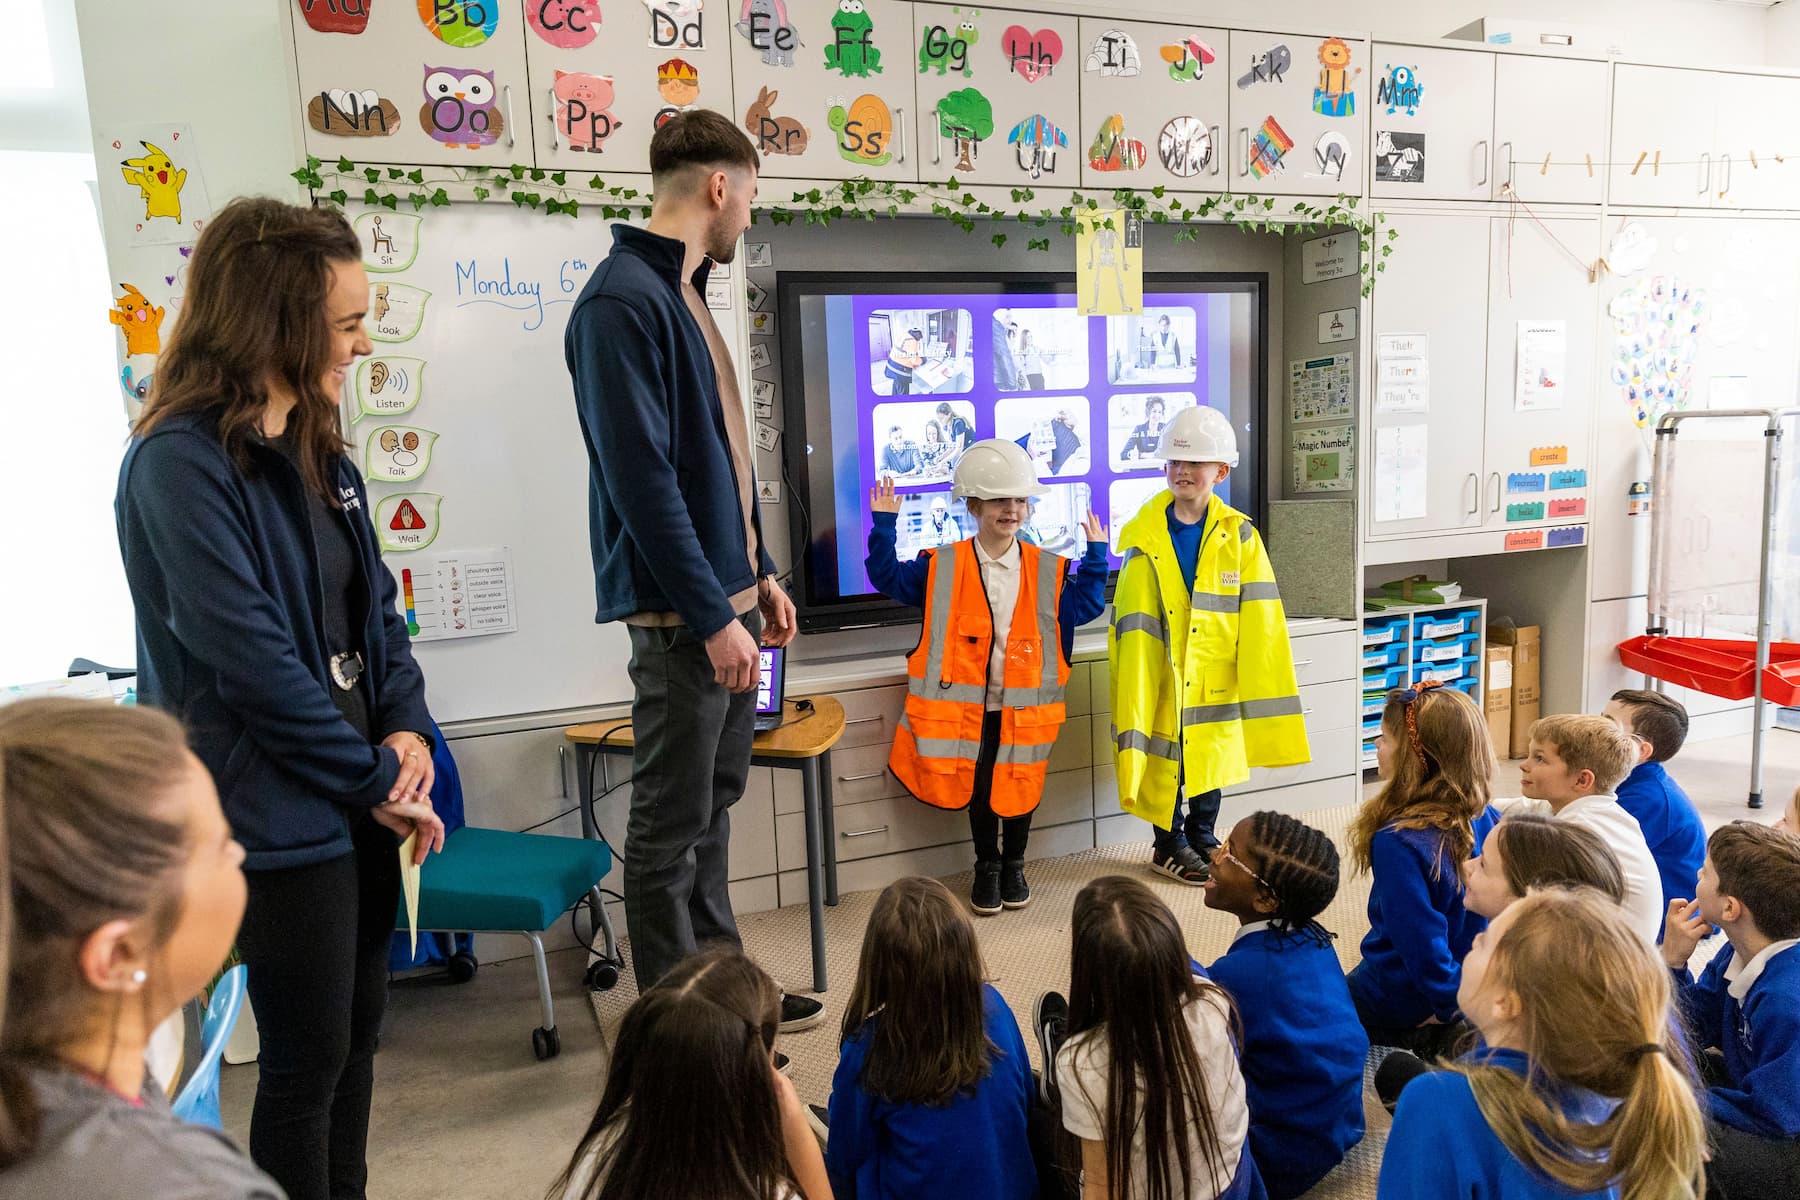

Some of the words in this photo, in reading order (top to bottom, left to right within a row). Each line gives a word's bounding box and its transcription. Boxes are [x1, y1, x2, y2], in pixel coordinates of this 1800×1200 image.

[433, 0, 486, 28] Bb
[539, 0, 588, 32] Cc
[653, 8, 704, 49] Dd
[749, 12, 794, 50] Ee
[835, 26, 873, 65] Ff
[926, 25, 968, 71] Gg
[1010, 39, 1053, 76] Hh
[1102, 37, 1127, 69] Ii
[1174, 40, 1203, 81] Jj
[1252, 53, 1283, 83] Kk
[1377, 77, 1419, 107] Mm
[321, 91, 388, 133] Nn
[431, 96, 490, 134] Oo
[567, 99, 611, 149] Pp
[759, 117, 801, 153] Rr
[841, 121, 882, 156] Ss
[946, 125, 983, 160] Tt
[1017, 141, 1056, 174] Uu
[1250, 137, 1287, 169] Xx
[1314, 146, 1347, 182] Yy
[1386, 152, 1418, 179] Zz
[380, 255, 393, 265] Sit
[1315, 258, 1337, 268] Welcome
[455, 257, 543, 330] Monday
[559, 259, 587, 293] 6th
[377, 324, 401, 336] Look
[1390, 340, 1415, 351] Their
[1389, 366, 1417, 377] There
[376, 399, 405, 409] Listen
[1298, 440, 1319, 452] Magic
[1320, 439, 1350, 449] Number
[387, 467, 406, 476] Talk
[1312, 457, 1328, 471] 54
[398, 534, 420, 544] Wait
[467, 566, 490, 574] shouting
[1367, 632, 1391, 641] resources
[1439, 623, 1462, 632] resources
